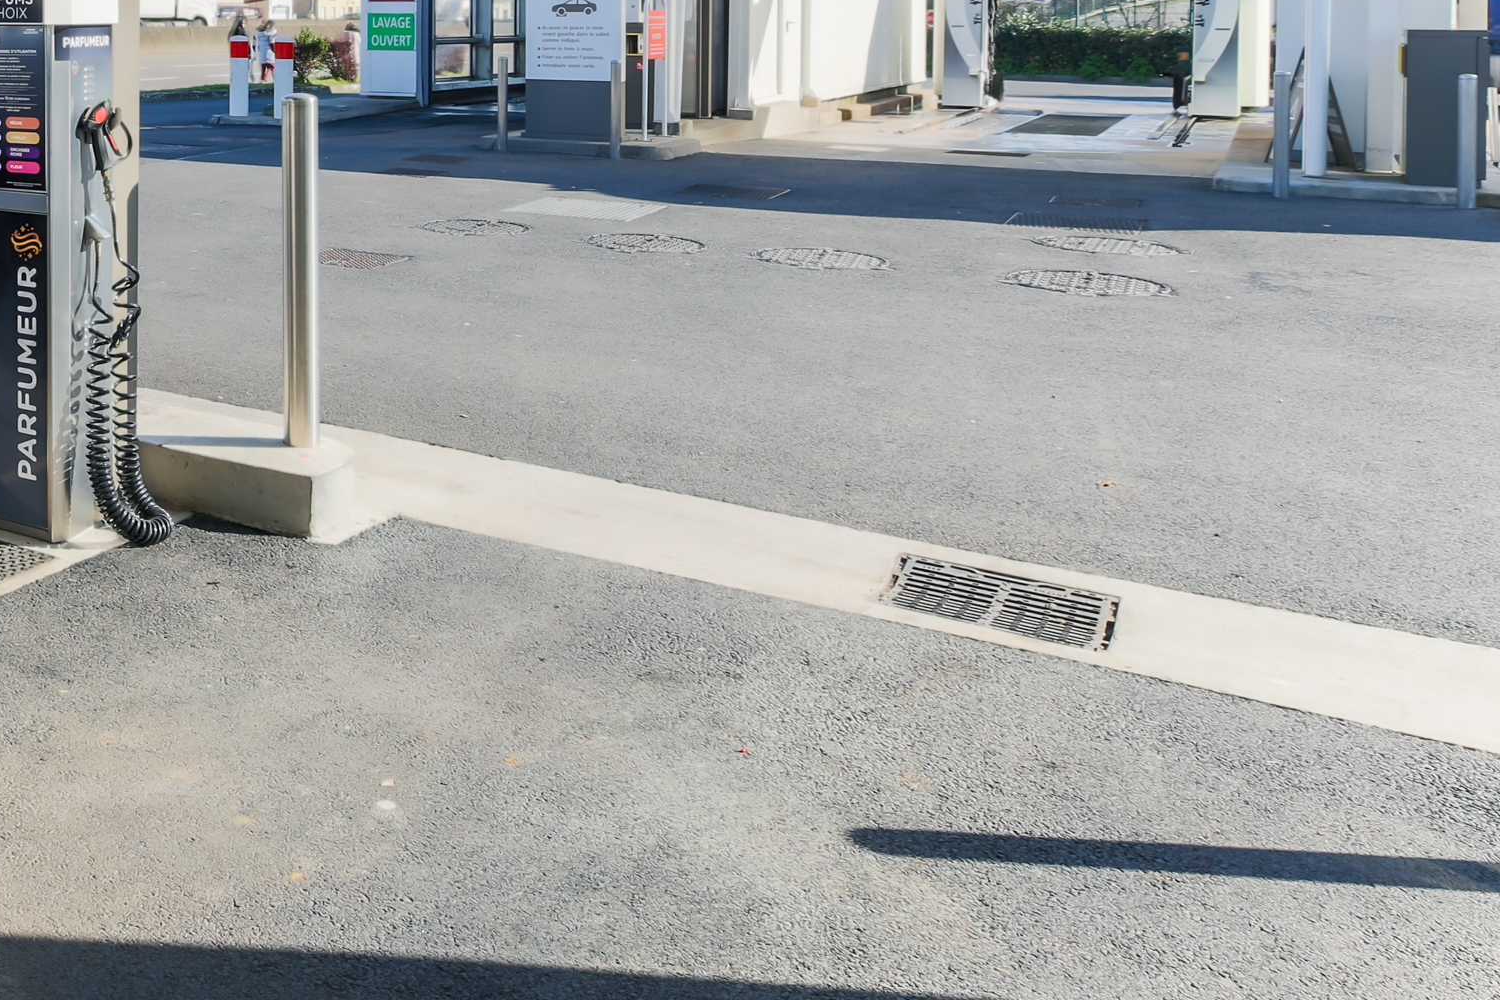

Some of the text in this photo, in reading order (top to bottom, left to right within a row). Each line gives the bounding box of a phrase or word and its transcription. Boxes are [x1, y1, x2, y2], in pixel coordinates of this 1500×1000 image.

[372, 16, 411, 29] LAVAGE
[62, 35, 110, 48] PARFUMEUR
[371, 34, 412, 47] OUVERT
[16, 265, 38, 481] PARFUMEUR
